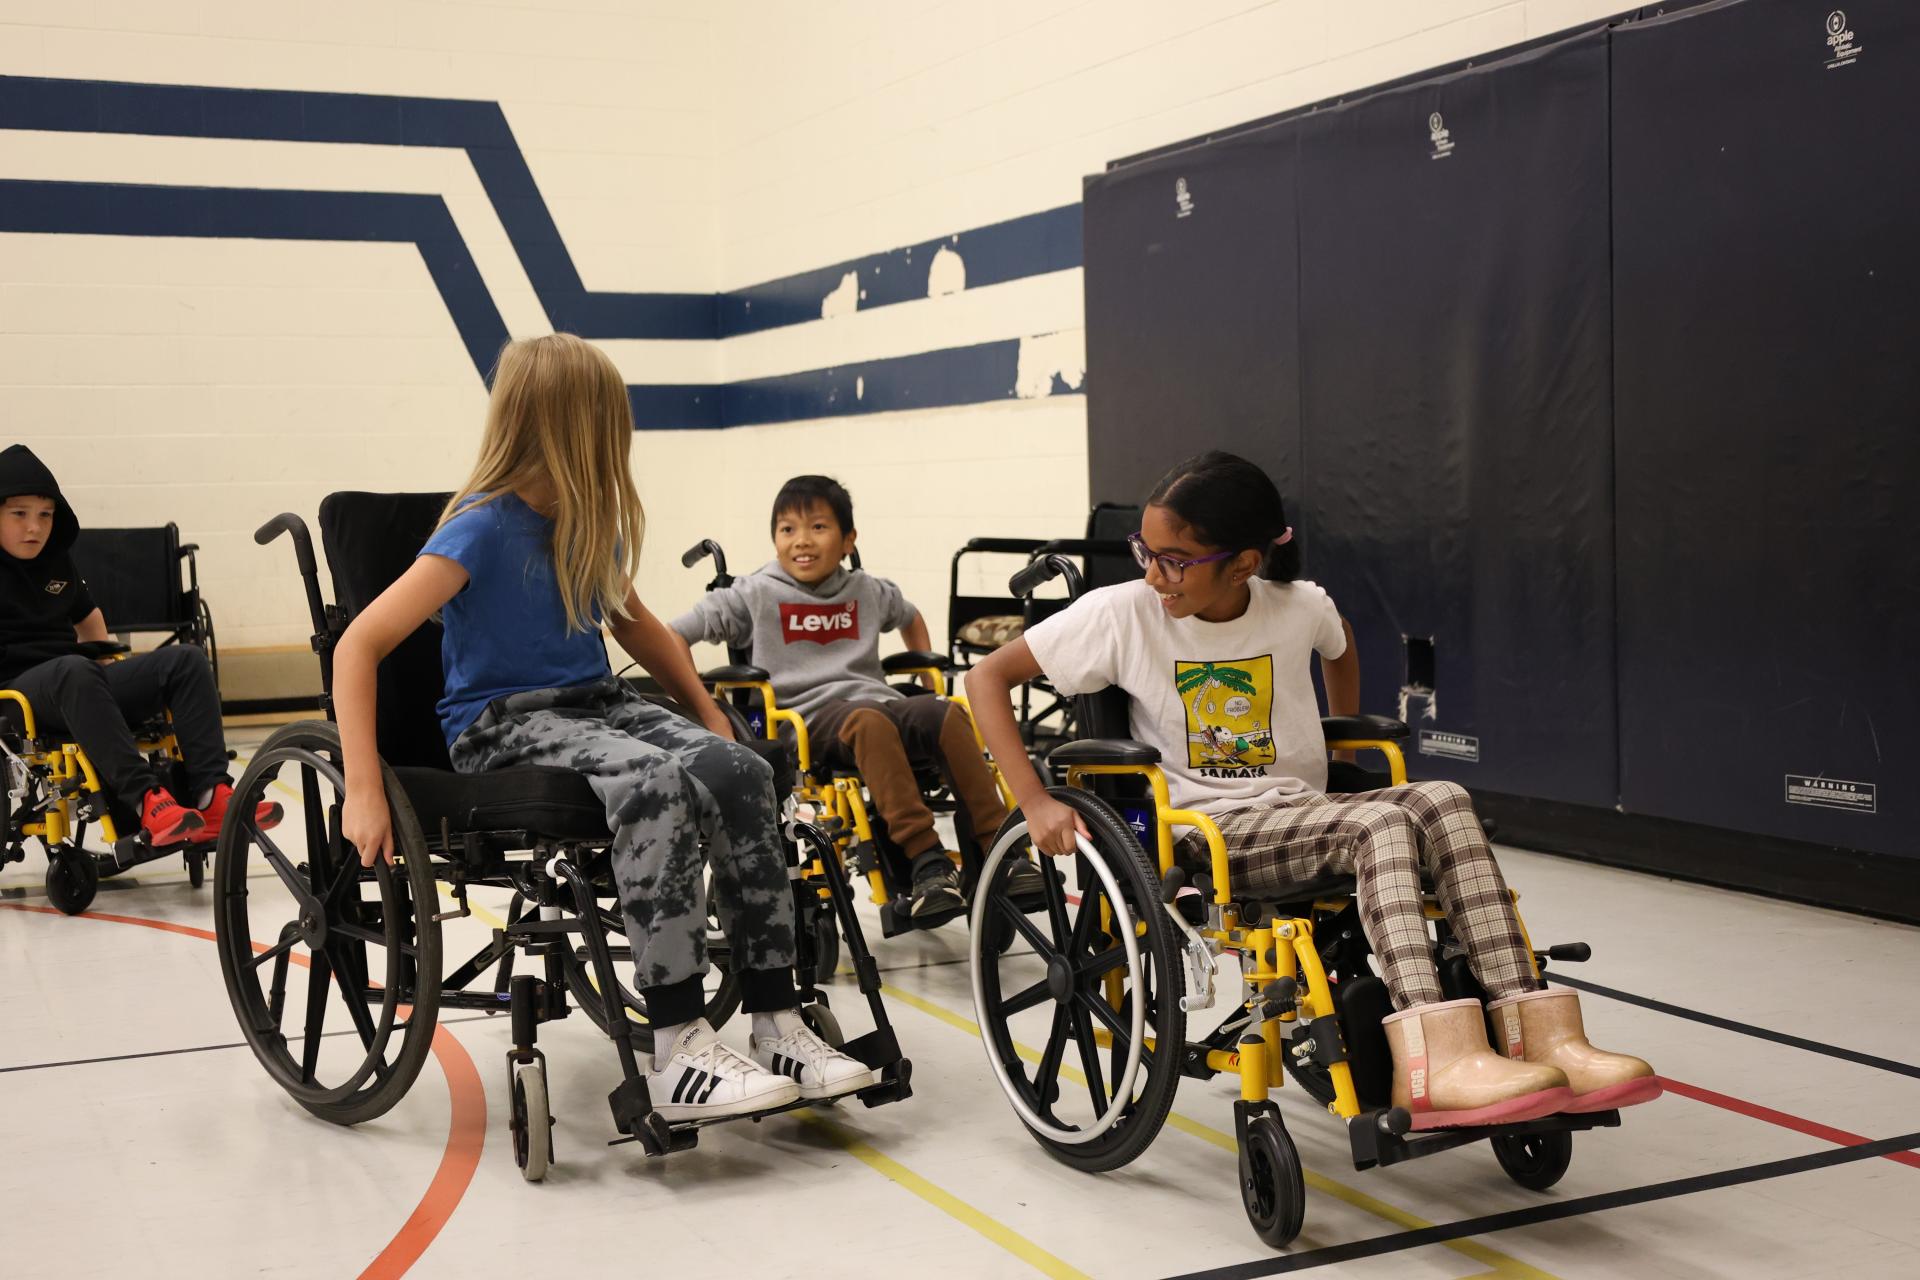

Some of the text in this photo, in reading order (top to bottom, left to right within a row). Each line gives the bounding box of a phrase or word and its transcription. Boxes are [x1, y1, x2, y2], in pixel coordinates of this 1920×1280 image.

[1826, 30, 1854, 47] apple
[1804, 780, 1856, 792] WARNING
[682, 1027, 700, 1047] adidas
[1410, 1068, 1426, 1099] UGG
